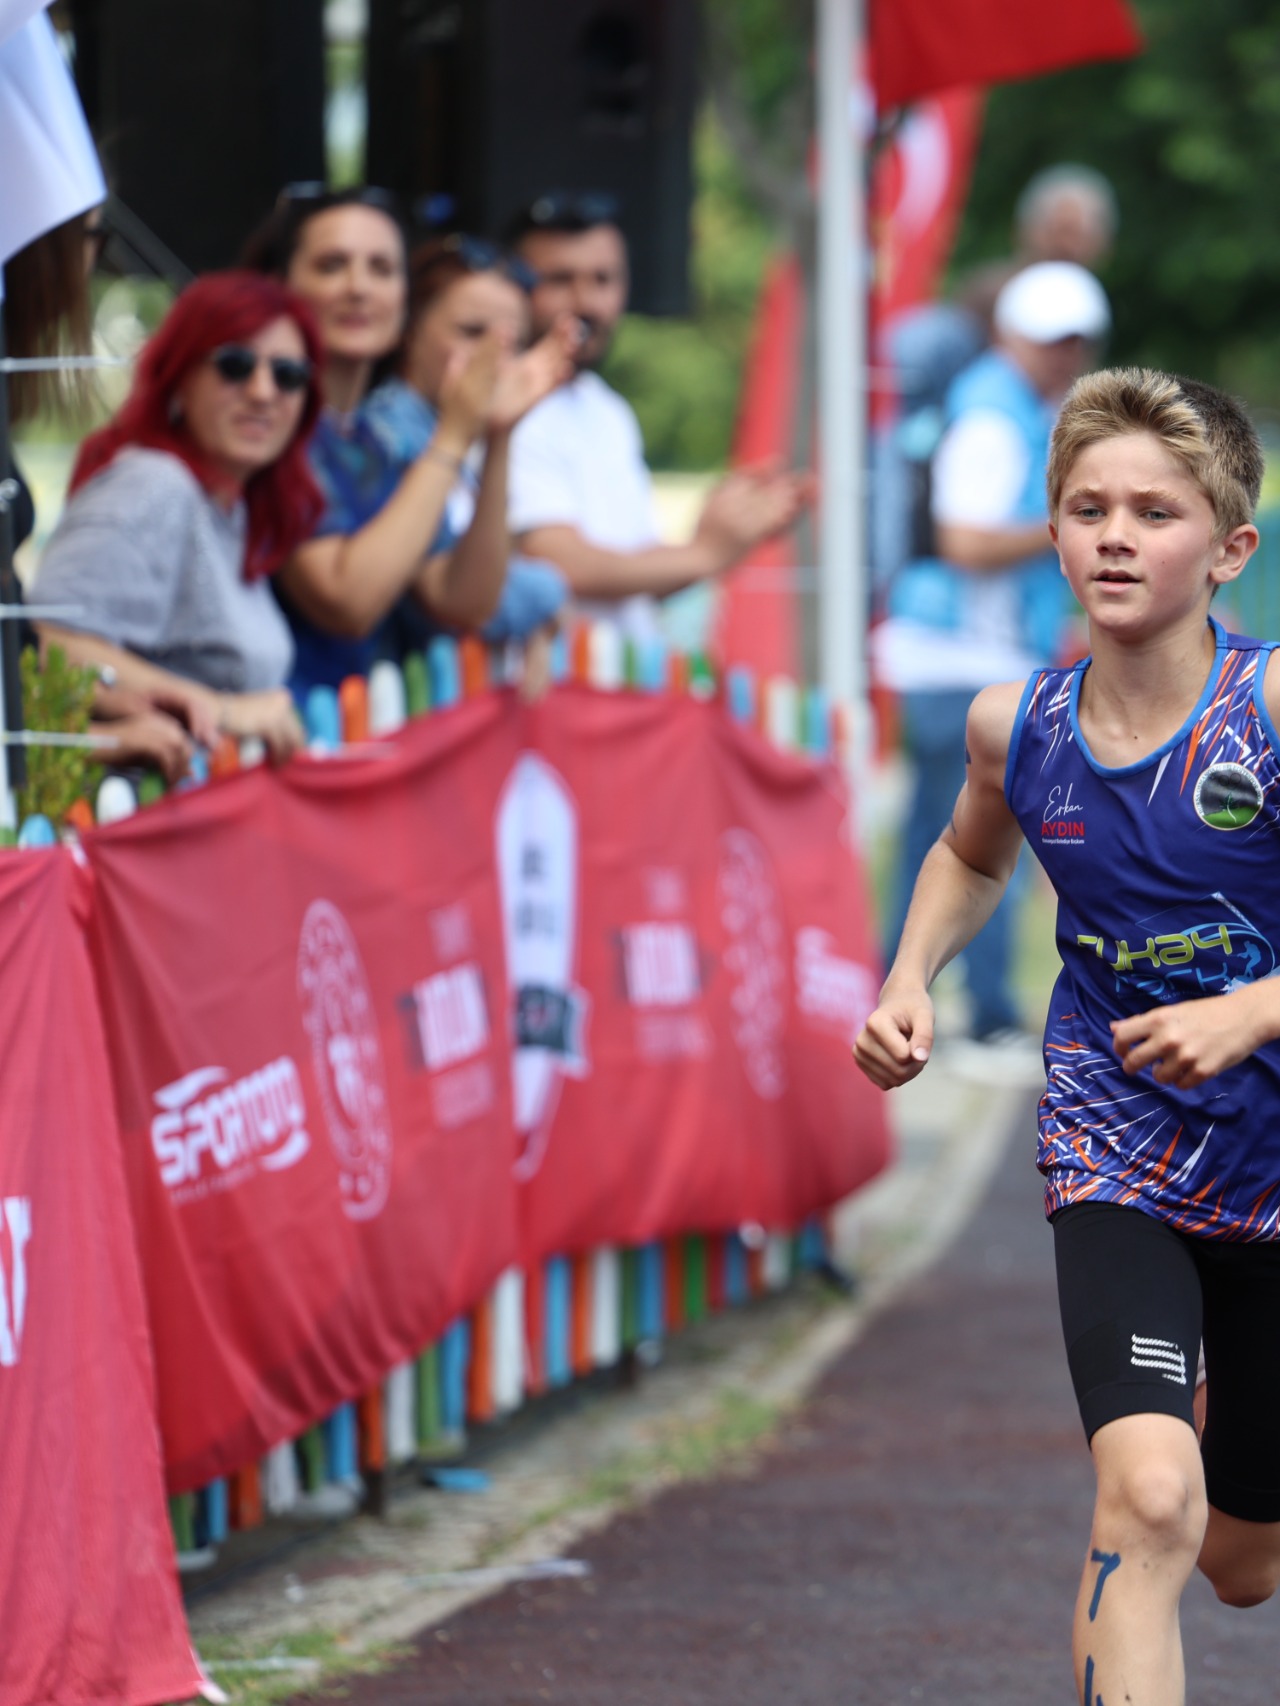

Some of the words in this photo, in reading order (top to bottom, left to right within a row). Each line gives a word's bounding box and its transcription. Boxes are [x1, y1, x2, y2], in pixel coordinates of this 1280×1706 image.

[1043, 782, 1084, 823] Erkan
[1041, 821, 1085, 837] AYDIN
[1088, 1547, 1121, 1622] 7
